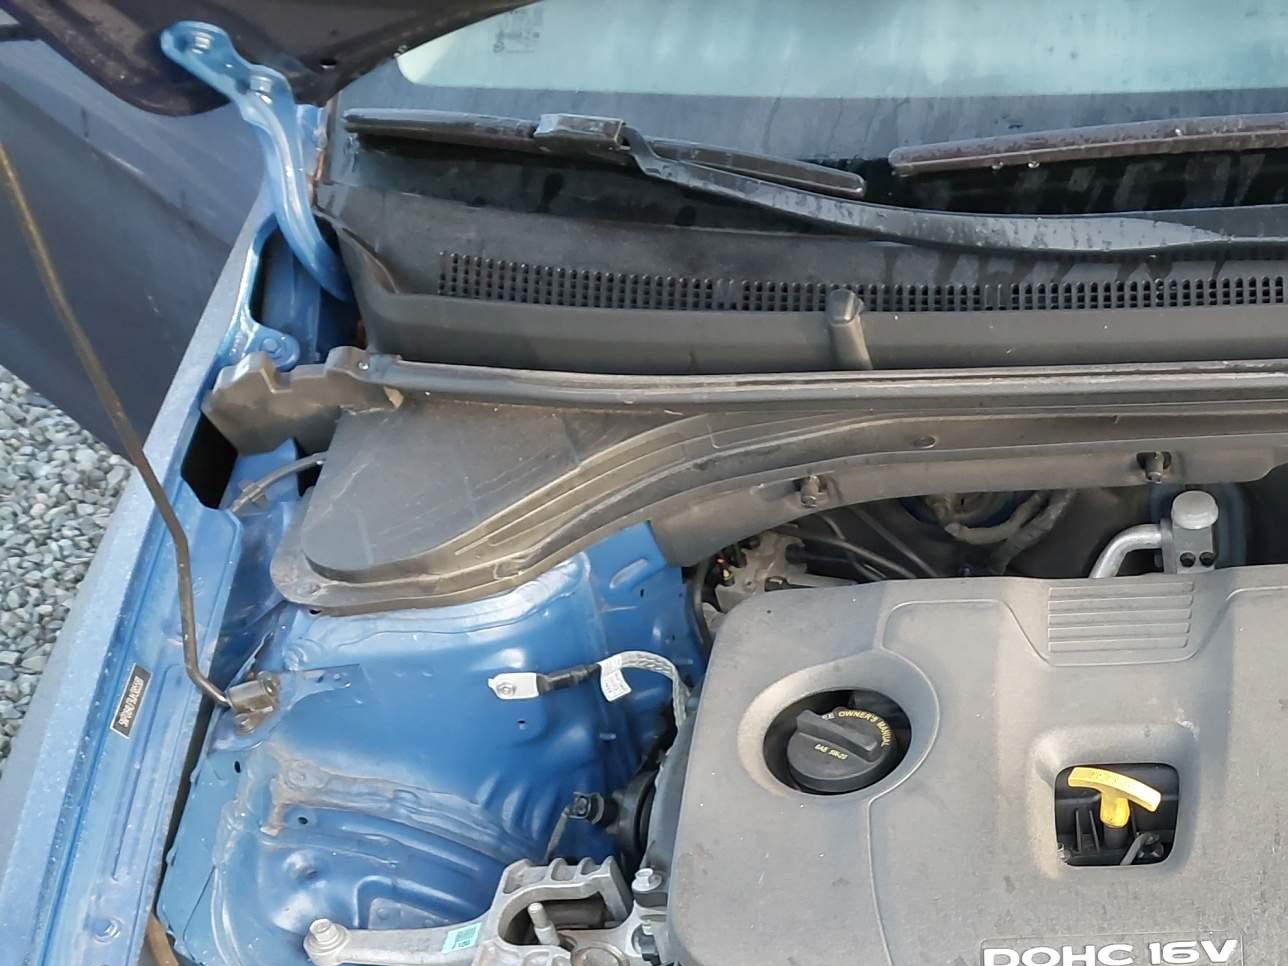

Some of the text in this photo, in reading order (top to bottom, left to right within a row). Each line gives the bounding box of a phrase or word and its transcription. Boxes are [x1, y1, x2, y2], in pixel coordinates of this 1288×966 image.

[838, 711, 879, 722] OWNER'S
[877, 719, 892, 747] MANUAL
[1149, 940, 1237, 965] 16V
